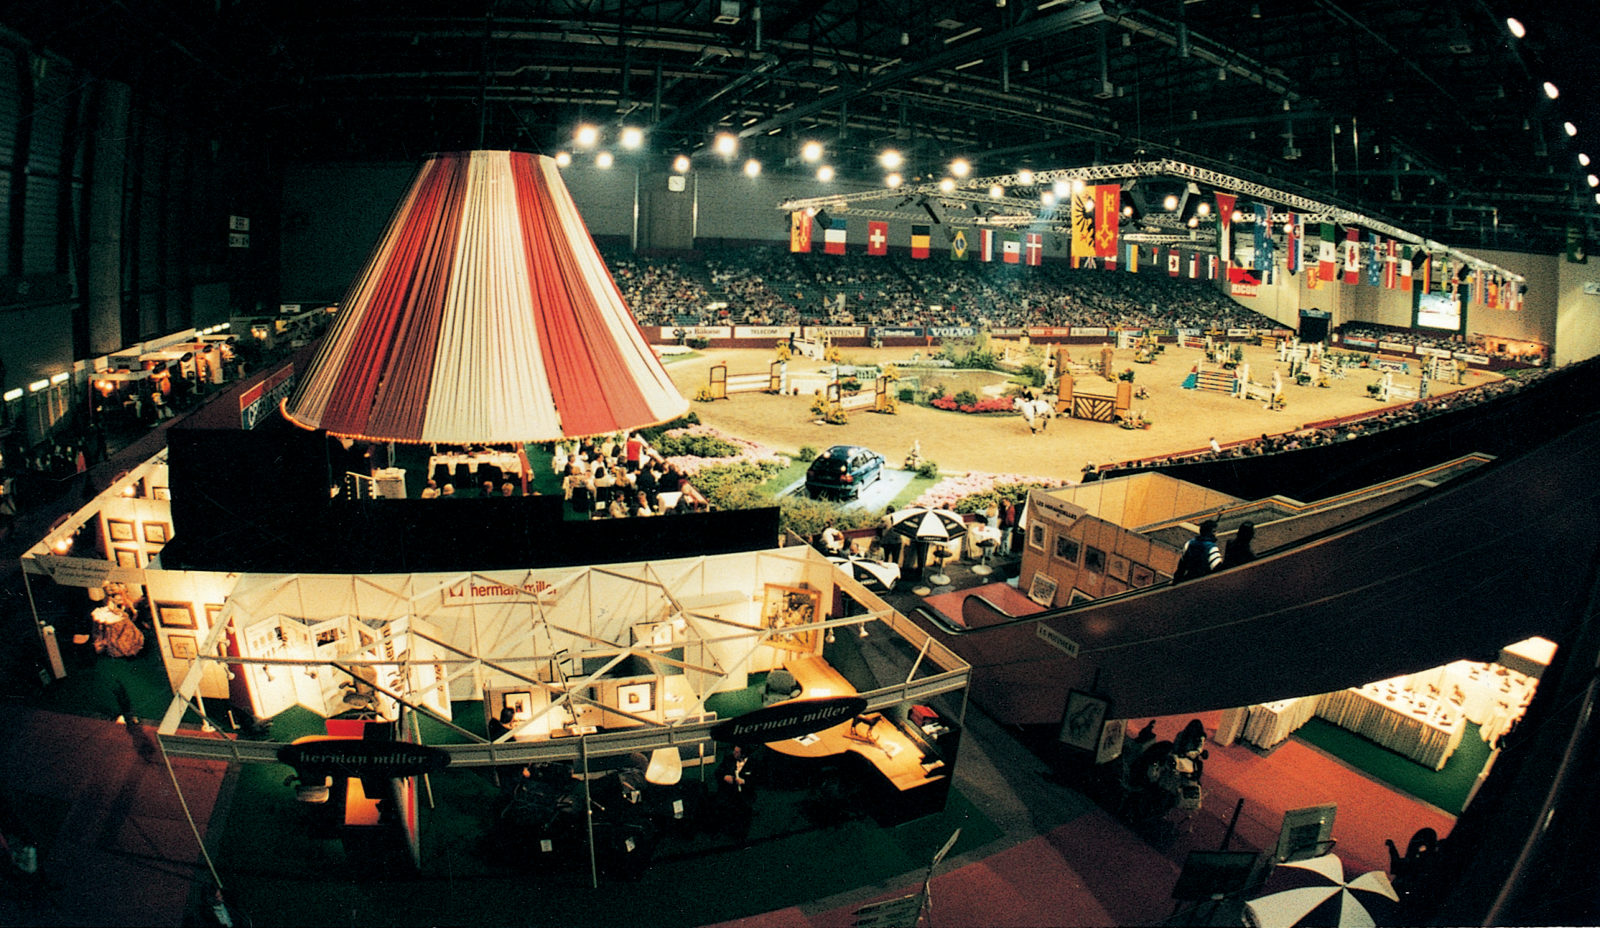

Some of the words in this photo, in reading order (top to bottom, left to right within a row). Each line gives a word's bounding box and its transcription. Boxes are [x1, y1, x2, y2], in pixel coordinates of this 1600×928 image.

[931, 327, 974, 336] VOLVO
[470, 582, 518, 597] herman
[733, 715, 798, 736] herman
[803, 704, 850, 724] miller
[299, 751, 368, 767] herman
[373, 751, 427, 766] miller
